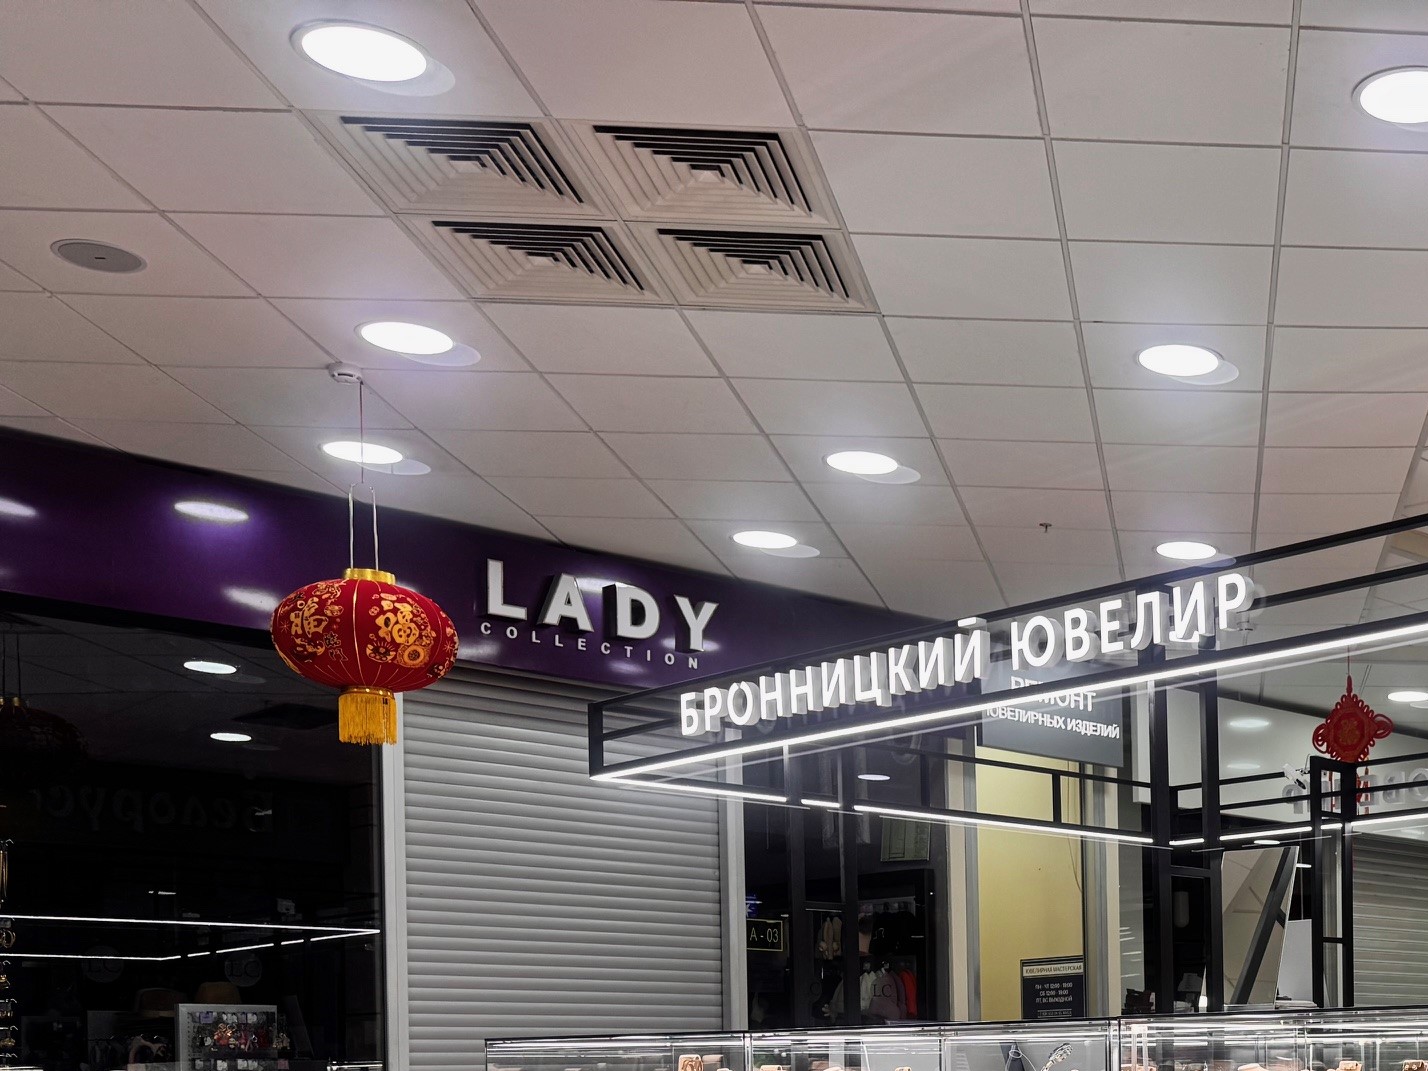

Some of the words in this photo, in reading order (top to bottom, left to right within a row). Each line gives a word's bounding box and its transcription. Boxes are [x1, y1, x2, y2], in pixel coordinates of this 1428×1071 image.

[486, 558, 720, 652] LADY
[480, 622, 698, 670] COLLECTION
[680, 618, 985, 737] БРОННИЦКИЙ
[1010, 573, 1249, 671] ЮВЕЛИР
[1010, 676, 1097, 712] РОНТ
[986, 706, 1065, 730] ЮВЕЛИРНЫХ
[1067, 717, 1120, 739] ИЗДЕЛИЙ
[766, 928, 779, 943] 03
